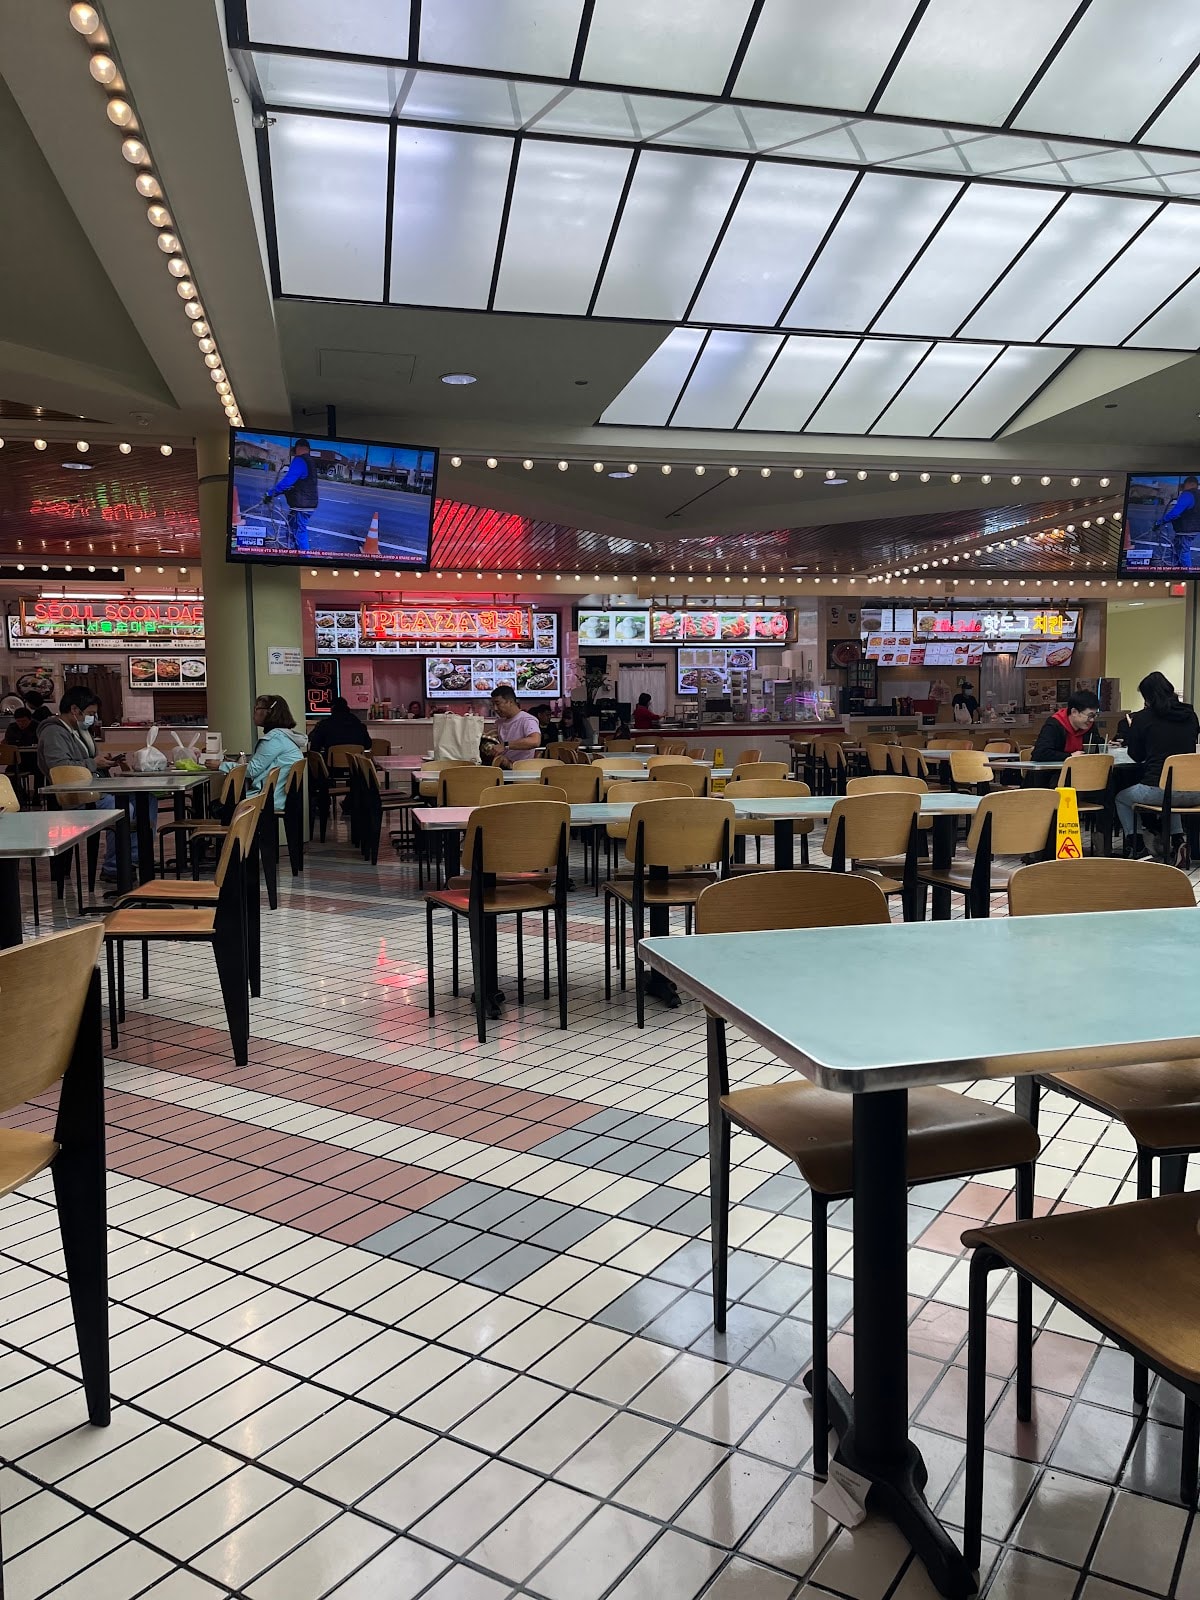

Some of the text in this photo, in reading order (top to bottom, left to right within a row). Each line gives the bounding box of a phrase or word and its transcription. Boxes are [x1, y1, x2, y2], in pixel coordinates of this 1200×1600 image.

[34, 604, 99, 620] SEOUL
[105, 604, 160, 621] SOON
[372, 610, 524, 636] PLAZA 한식
[983, 615, 1031, 635] 핫도그
[1032, 615, 1063, 635] 치킨
[308, 661, 332, 712] 냉면
[354, 675, 362, 684] A
